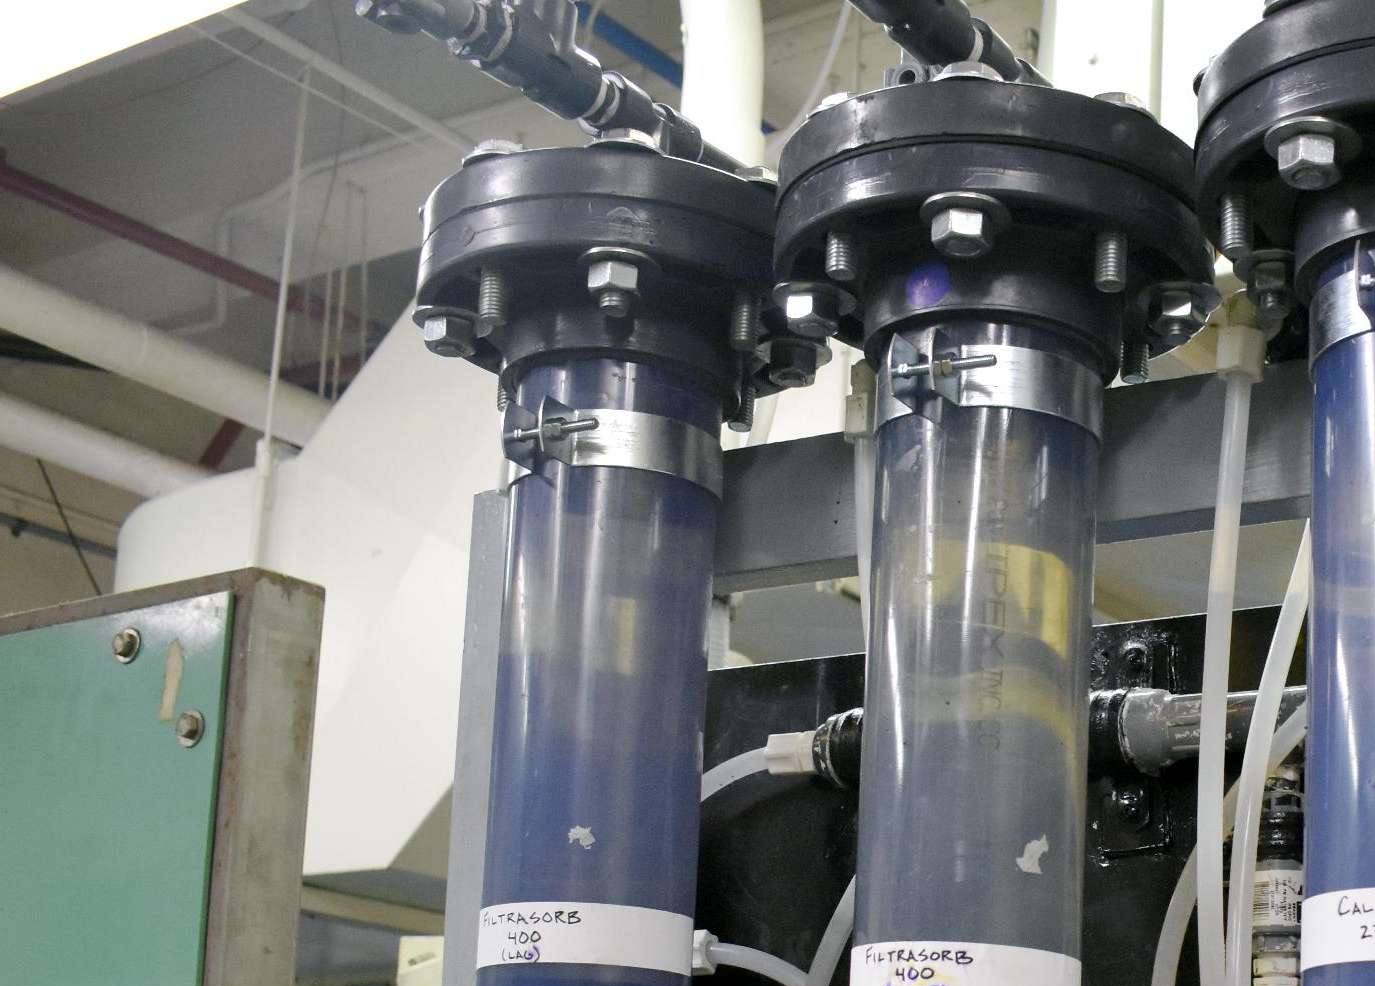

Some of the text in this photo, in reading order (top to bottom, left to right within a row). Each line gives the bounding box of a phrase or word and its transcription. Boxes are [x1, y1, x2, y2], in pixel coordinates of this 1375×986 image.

[482, 910, 582, 927] FILTRASORB
[507, 930, 542, 945] 400
[864, 946, 974, 966] FILTRASORB
[895, 966, 935, 980] 400
